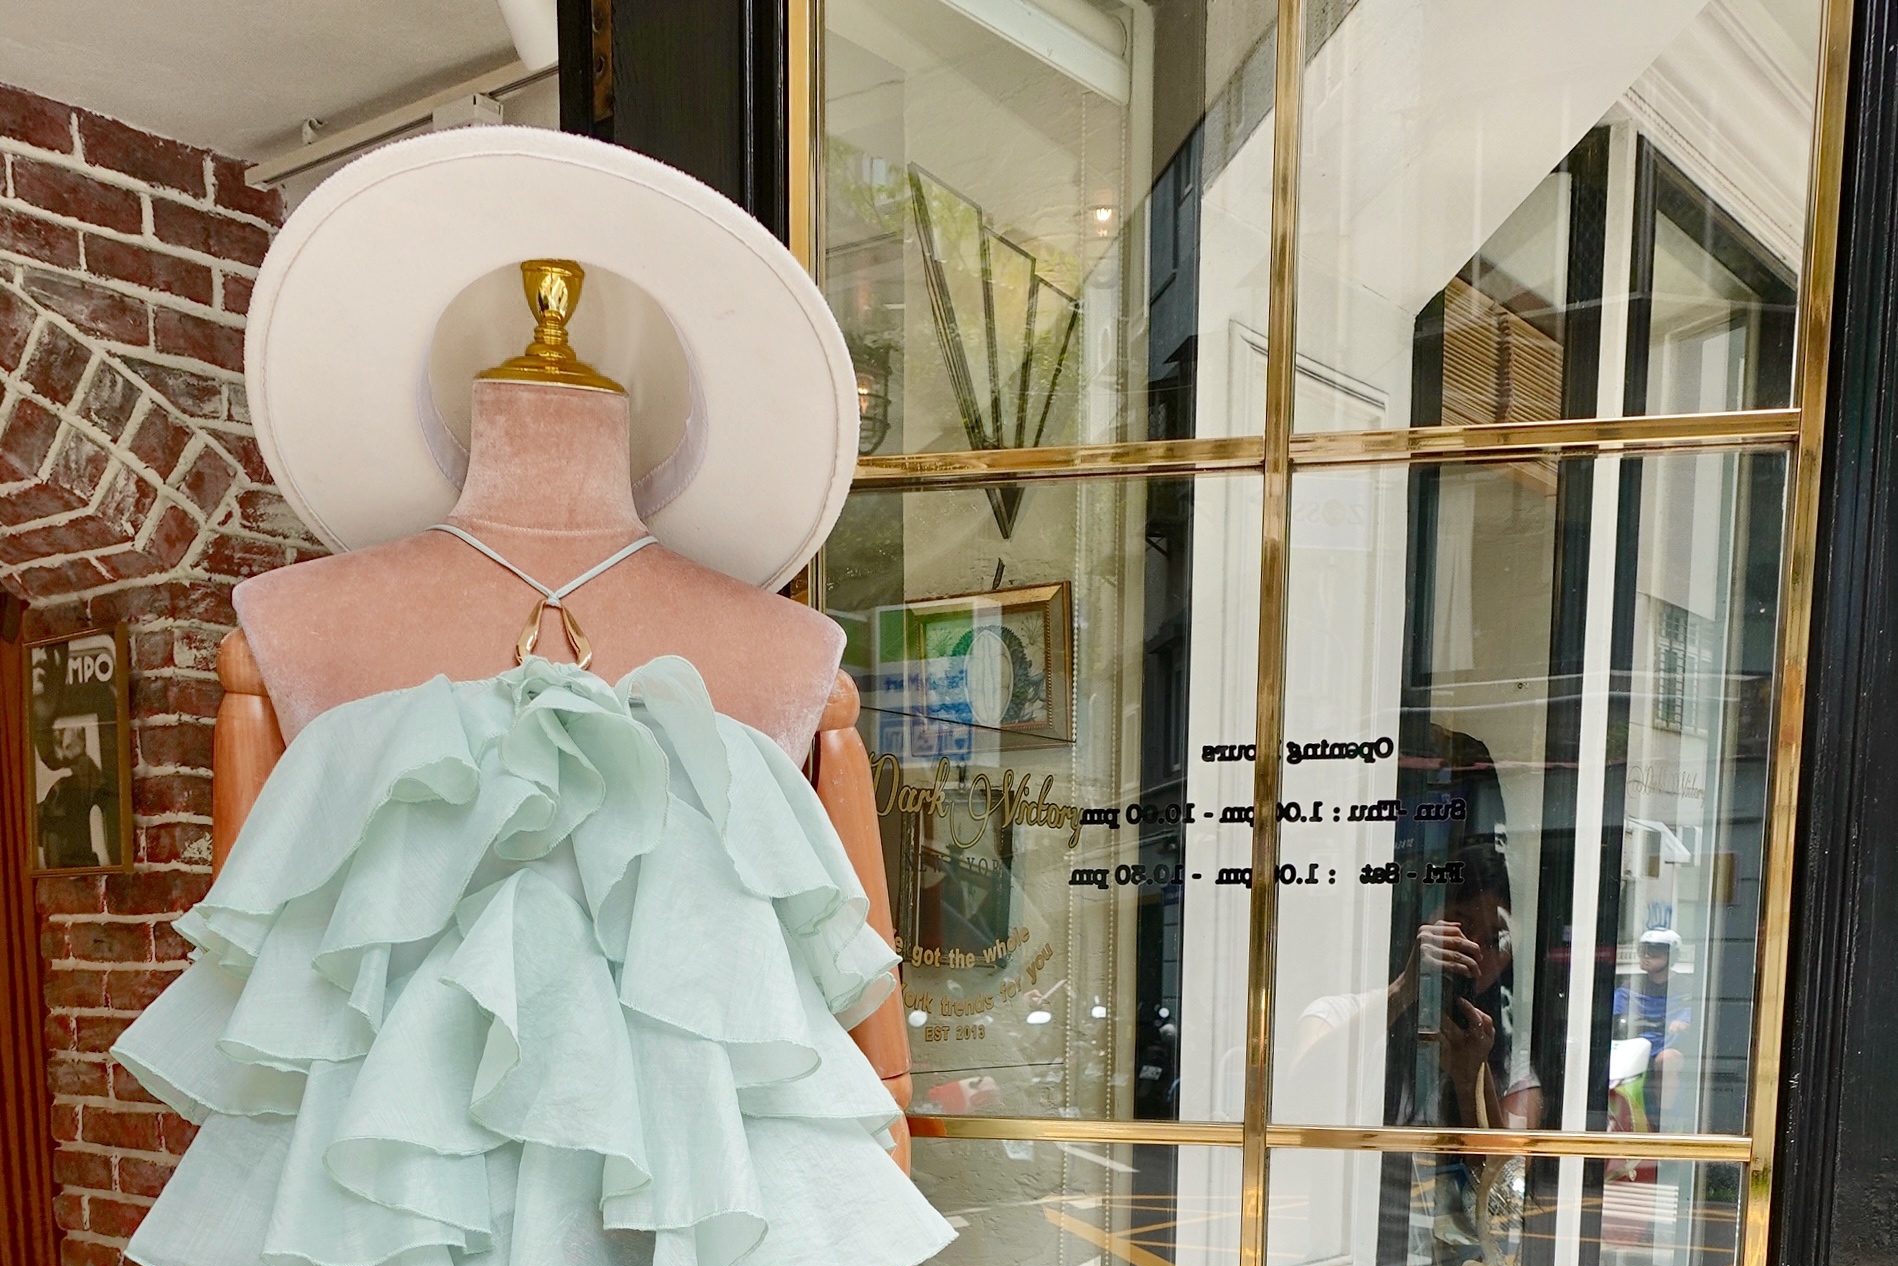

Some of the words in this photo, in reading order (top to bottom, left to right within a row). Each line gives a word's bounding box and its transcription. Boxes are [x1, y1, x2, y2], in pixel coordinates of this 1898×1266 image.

[869, 752, 950, 818] Dark
[951, 769, 1084, 848] Victory
[966, 857, 1006, 877] YOR
[911, 945, 941, 968] got
[949, 948, 976, 969] the
[983, 926, 1030, 964] whole
[940, 994, 994, 1017] trends
[1000, 975, 1022, 1003] for
[1026, 943, 1054, 985] you
[925, 1025, 951, 1042] EST
[956, 1024, 986, 1041] 2013
